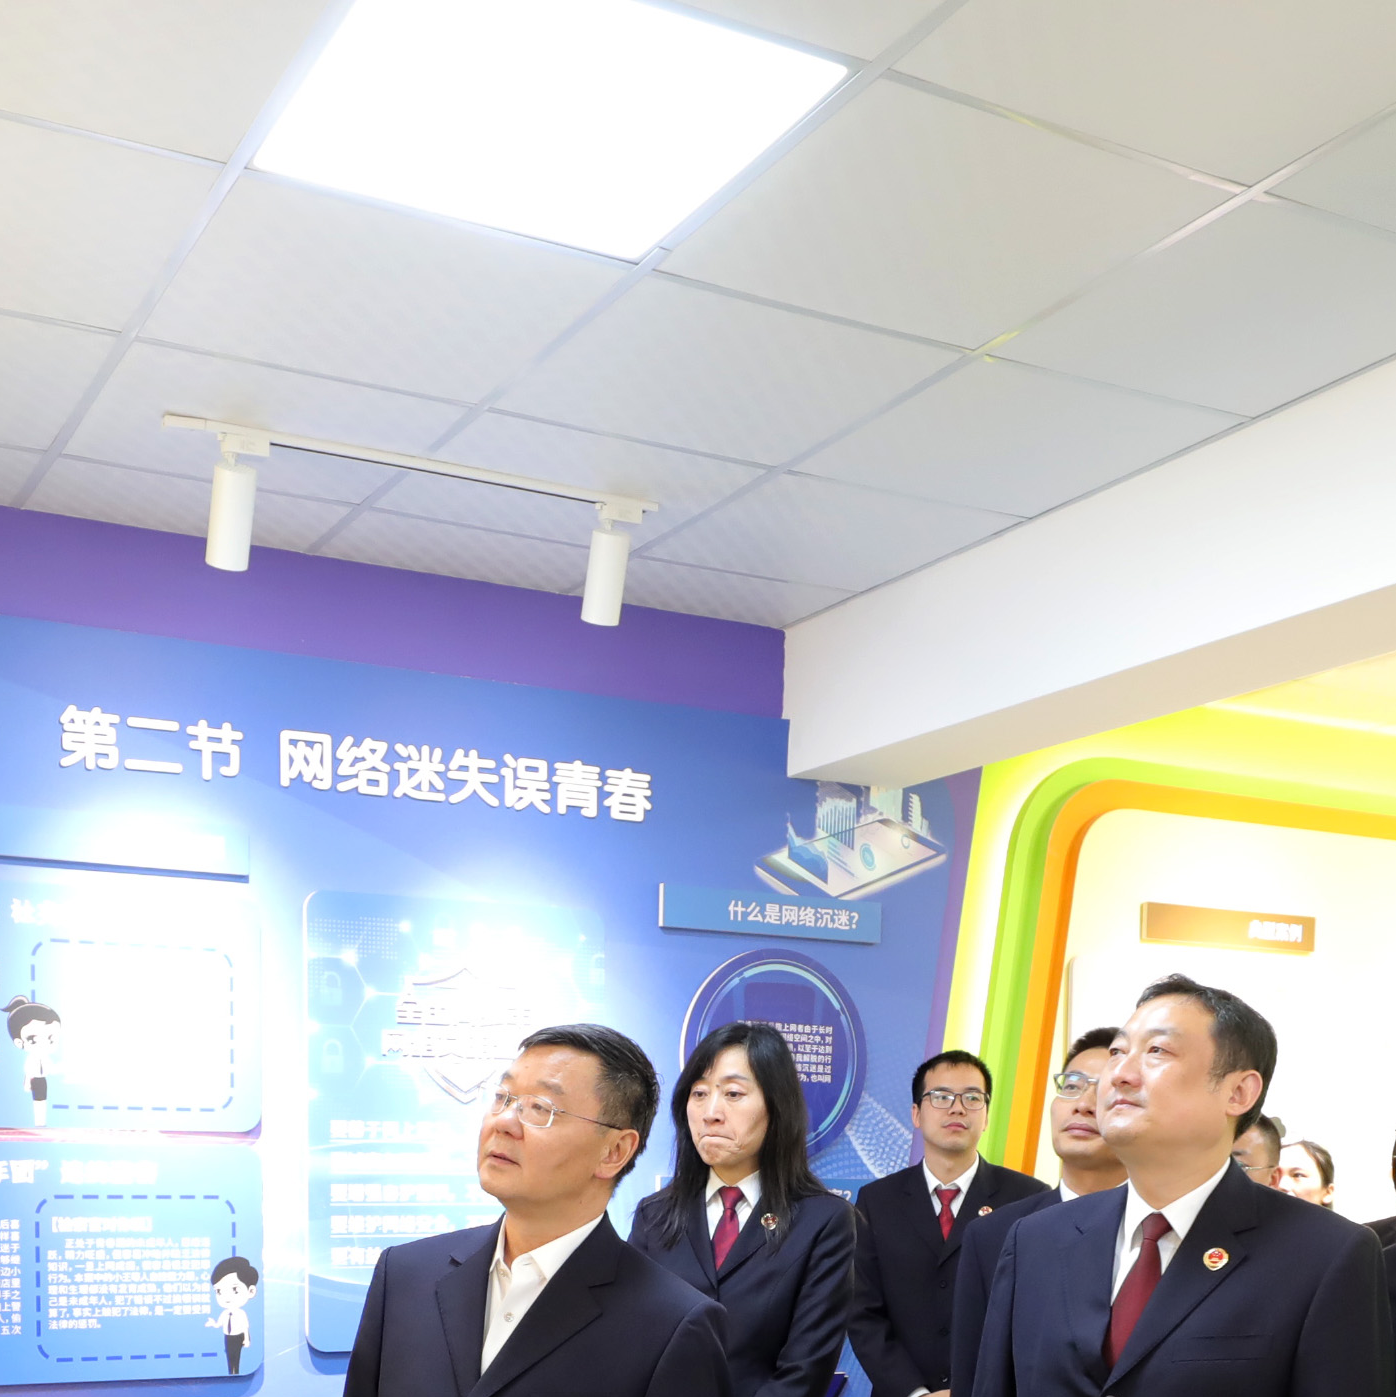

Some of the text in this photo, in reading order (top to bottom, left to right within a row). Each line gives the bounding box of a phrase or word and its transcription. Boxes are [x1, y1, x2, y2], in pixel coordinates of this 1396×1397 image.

[59, 703, 653, 823] 第二节 网络迷失误青春
[728, 899, 860, 930] 什么是网络沉迷？
